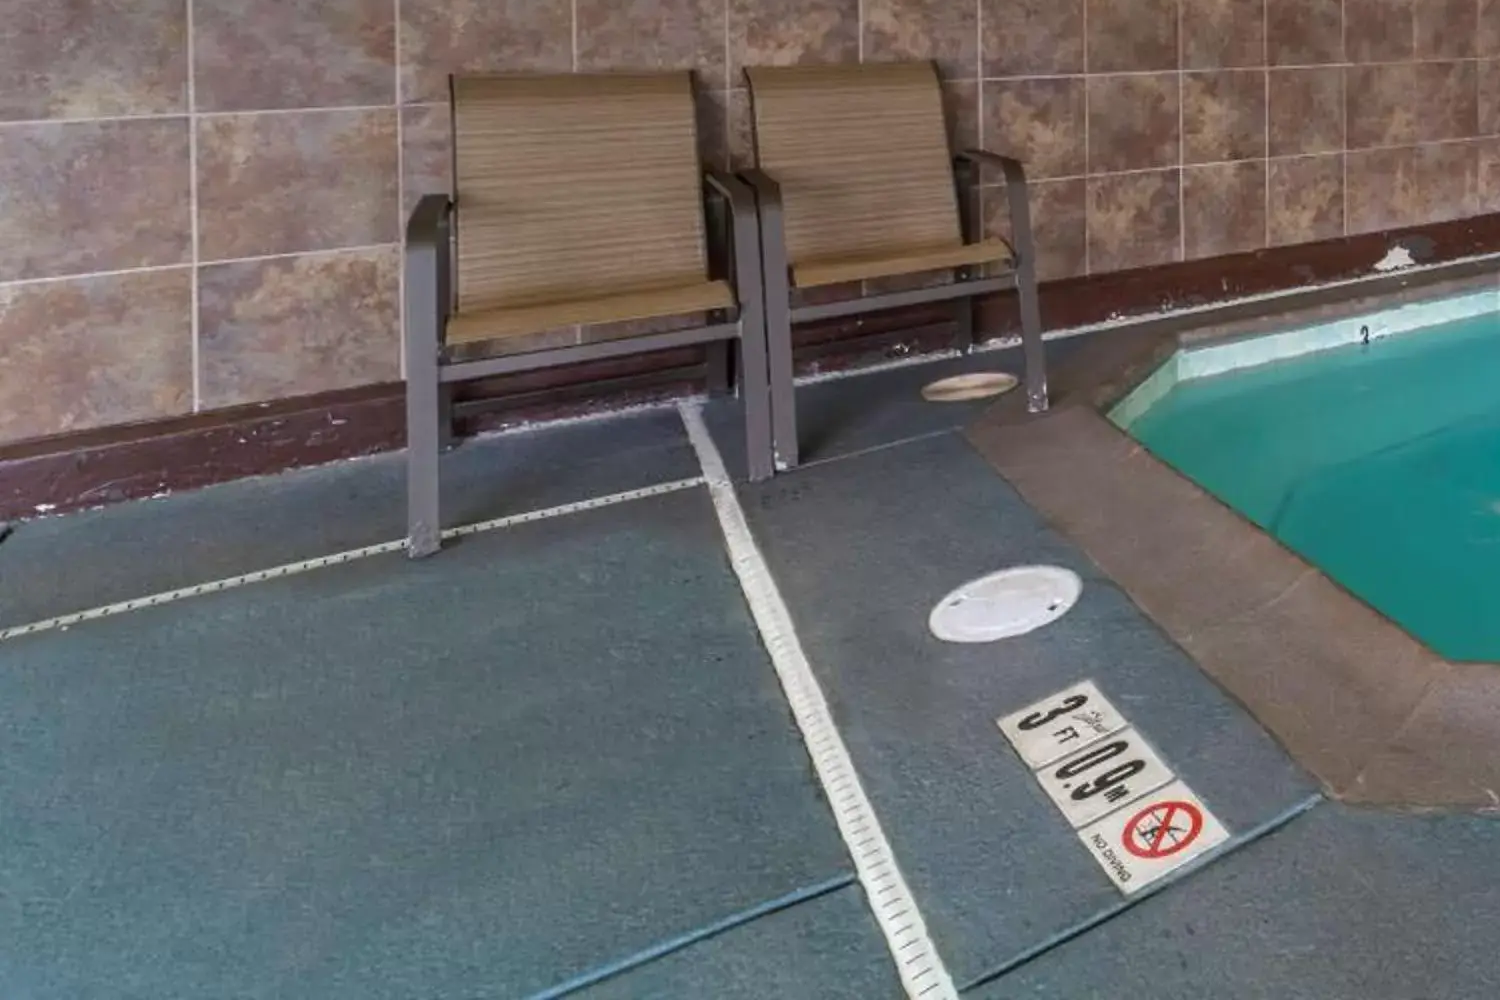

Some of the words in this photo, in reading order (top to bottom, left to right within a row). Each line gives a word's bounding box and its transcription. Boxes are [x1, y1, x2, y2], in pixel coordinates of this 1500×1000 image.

[1018, 694, 1089, 732] 3
[1052, 725, 1081, 745] FT
[1055, 739, 1147, 801] 0.9
[1090, 832, 1108, 850] NO
[1102, 847, 1132, 883] DIVING
